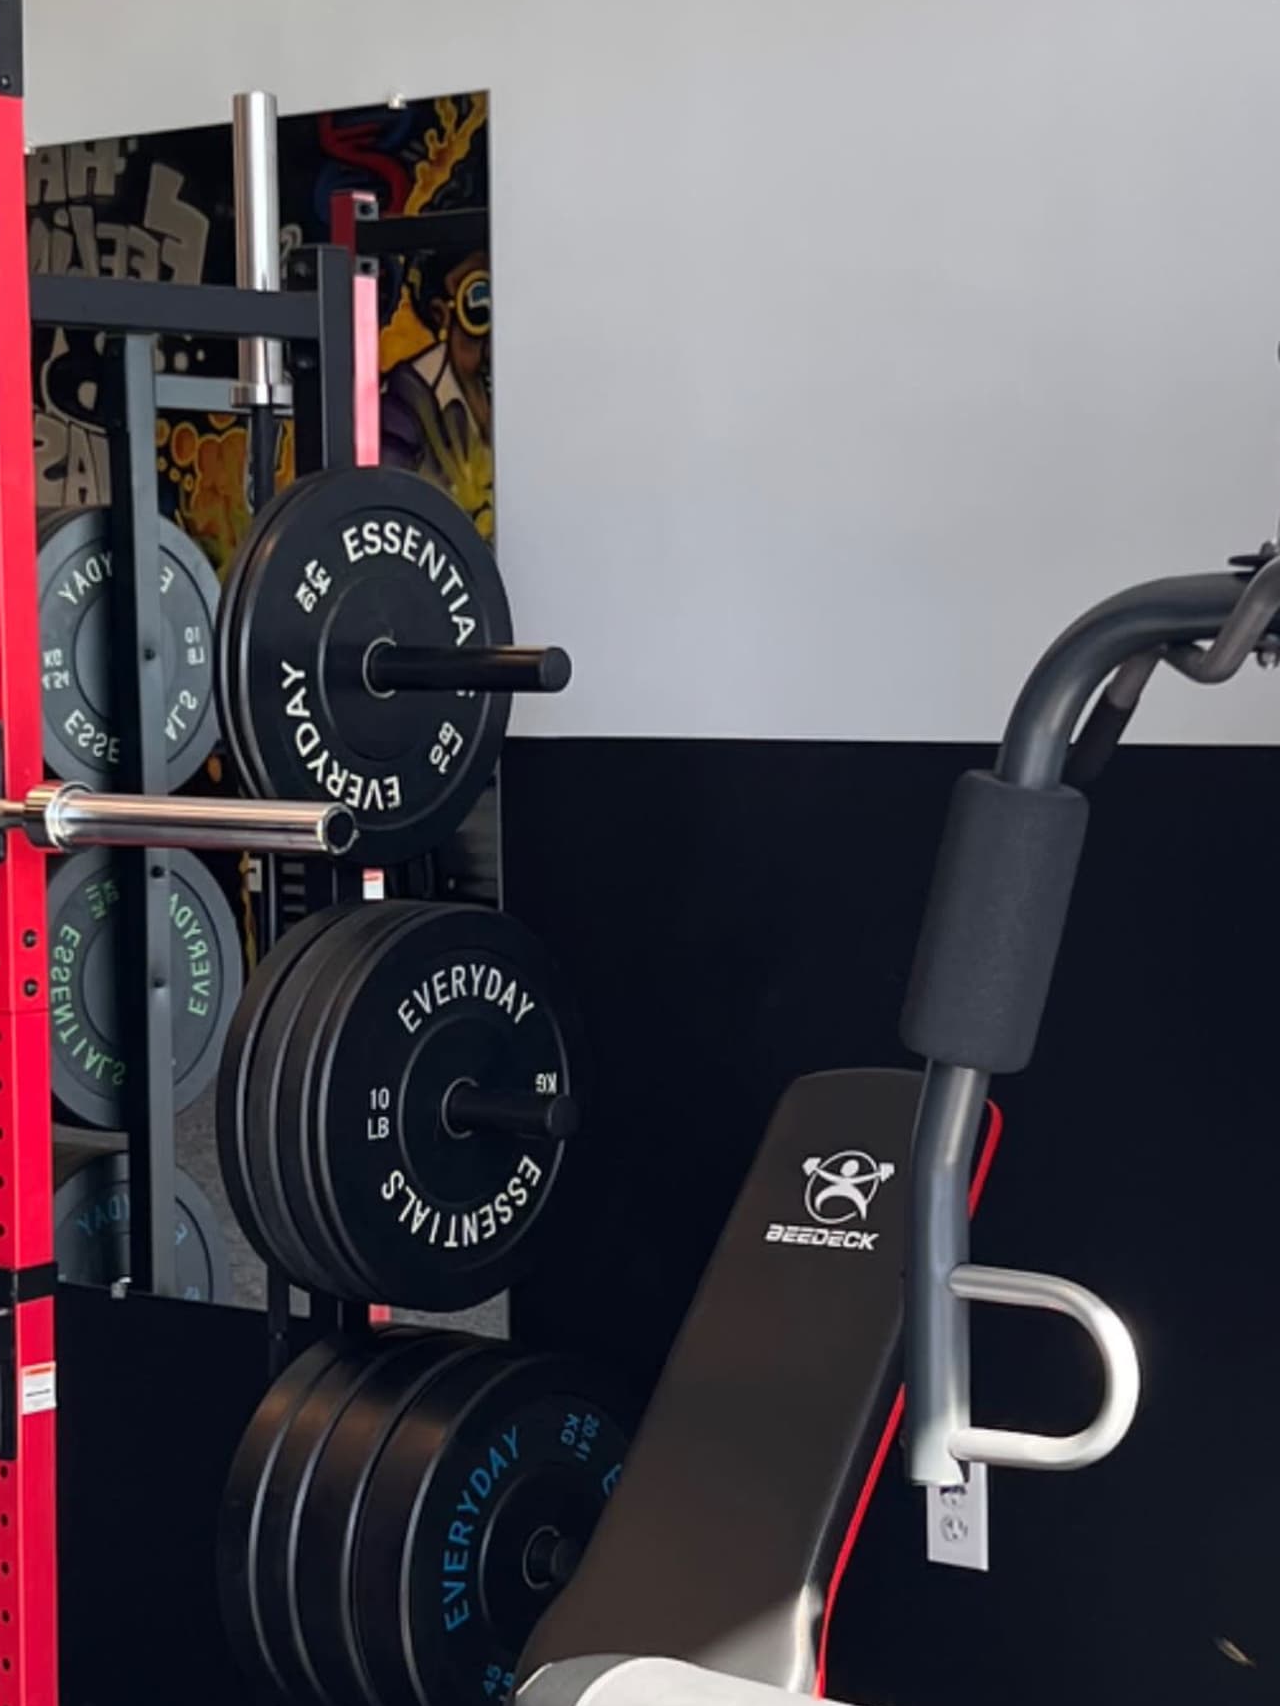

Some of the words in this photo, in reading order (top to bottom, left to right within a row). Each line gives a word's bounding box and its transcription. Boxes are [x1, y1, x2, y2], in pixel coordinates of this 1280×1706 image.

[341, 520, 478, 700] ESSENTIA
[280, 660, 403, 812] EVERYDAY
[437, 722, 464, 755] LB
[428, 748, 453, 776] 10
[397, 963, 536, 1035] EVERYDAY
[369, 1087, 390, 1111] 10
[535, 1072, 558, 1094] KG
[367, 1118, 390, 1141] LB
[381, 1154, 543, 1249] ESSENTIALS
[764, 1222, 880, 1252] BEEDECK
[442, 1425, 521, 1634] EVERYDAY
